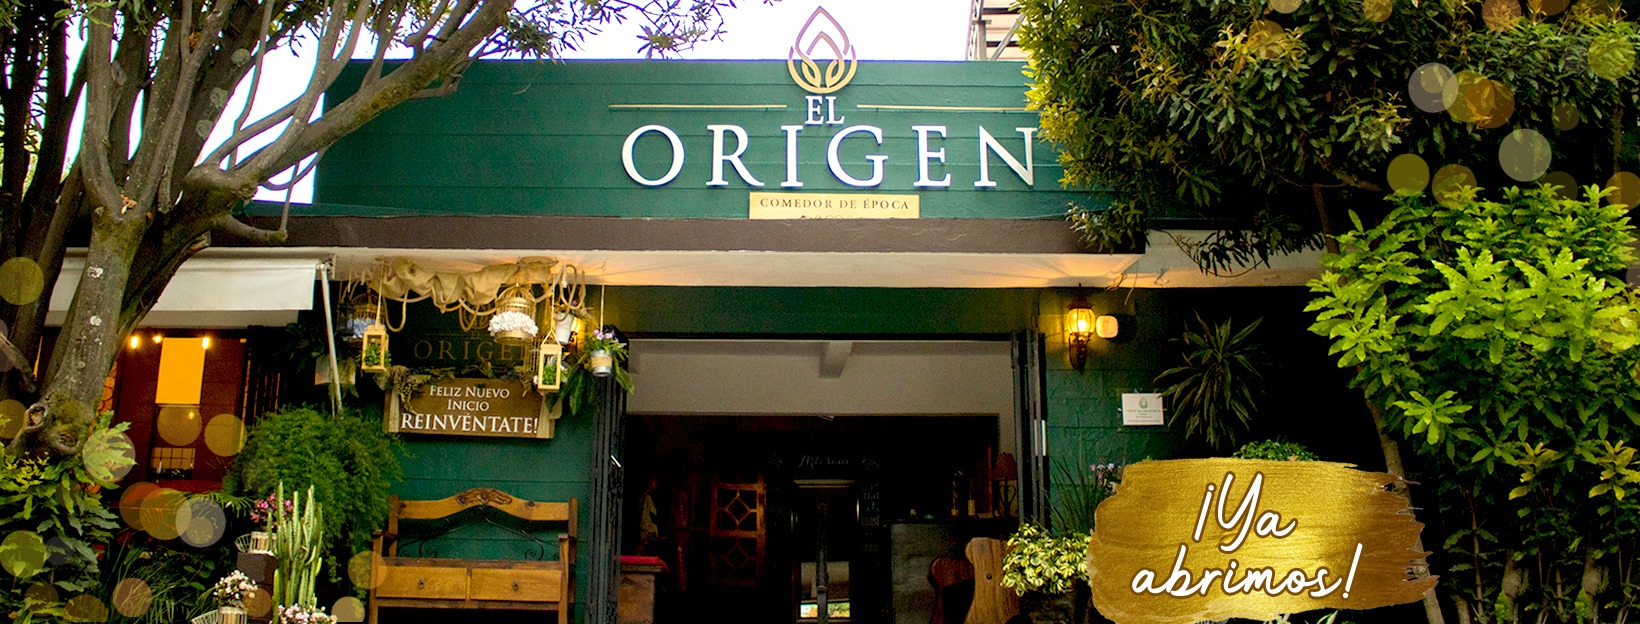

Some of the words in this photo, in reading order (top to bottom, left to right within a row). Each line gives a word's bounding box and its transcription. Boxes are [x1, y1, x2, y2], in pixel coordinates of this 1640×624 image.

[804, 95, 845, 125] EL
[620, 124, 1038, 188] ORIGEN
[760, 198, 833, 209] COMEDOR
[839, 199, 857, 209] DE
[863, 198, 909, 210] ÉPOCA
[429, 385, 462, 397] FELIZ
[465, 386, 510, 399] NUEVO
[447, 399, 490, 411] INICIO
[401, 412, 539, 434] REINVÉNTATE!
